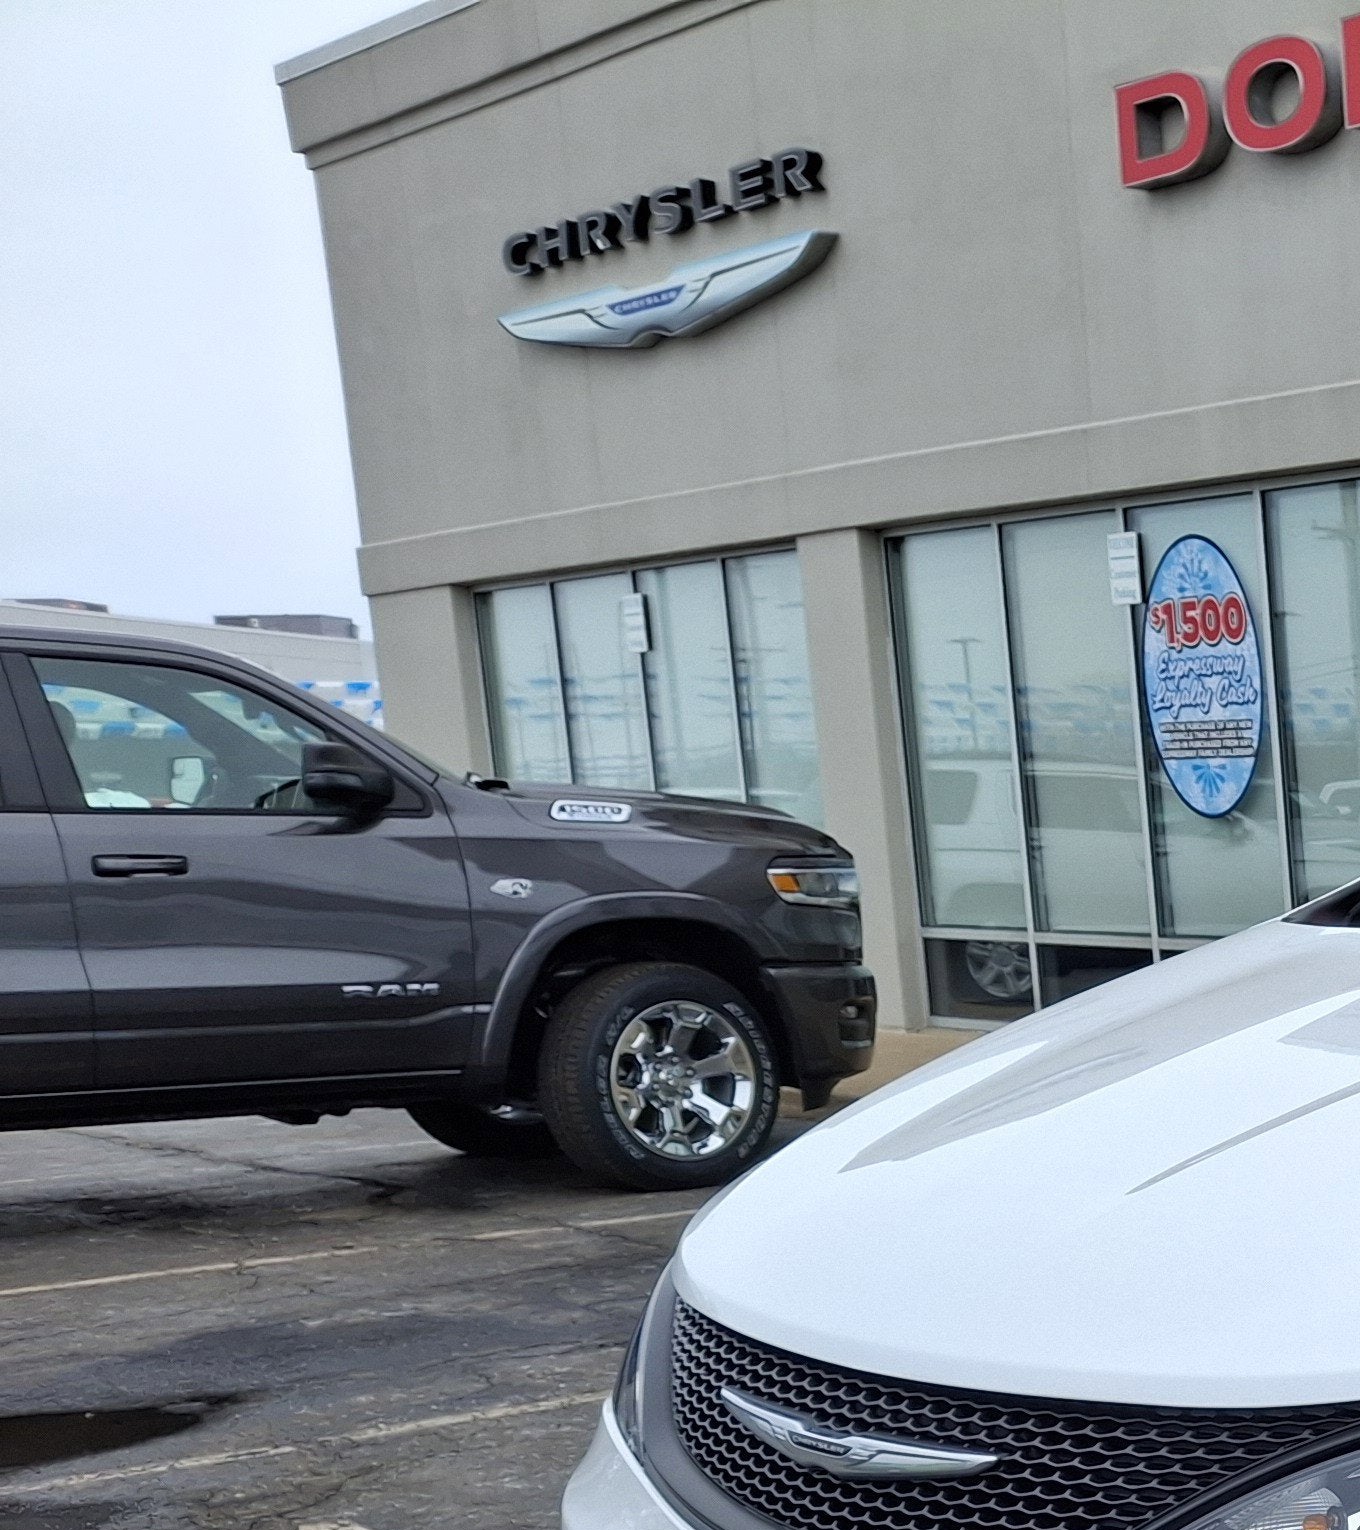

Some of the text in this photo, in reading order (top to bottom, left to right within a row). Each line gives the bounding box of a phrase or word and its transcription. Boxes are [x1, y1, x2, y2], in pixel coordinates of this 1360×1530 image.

[503, 147, 827, 276] CHRYSLER
[1149, 592, 1246, 653] $1,500
[1157, 651, 1245, 686] Expressway
[1152, 675, 1258, 718] Loyalty Cash
[341, 982, 441, 998] RAM
